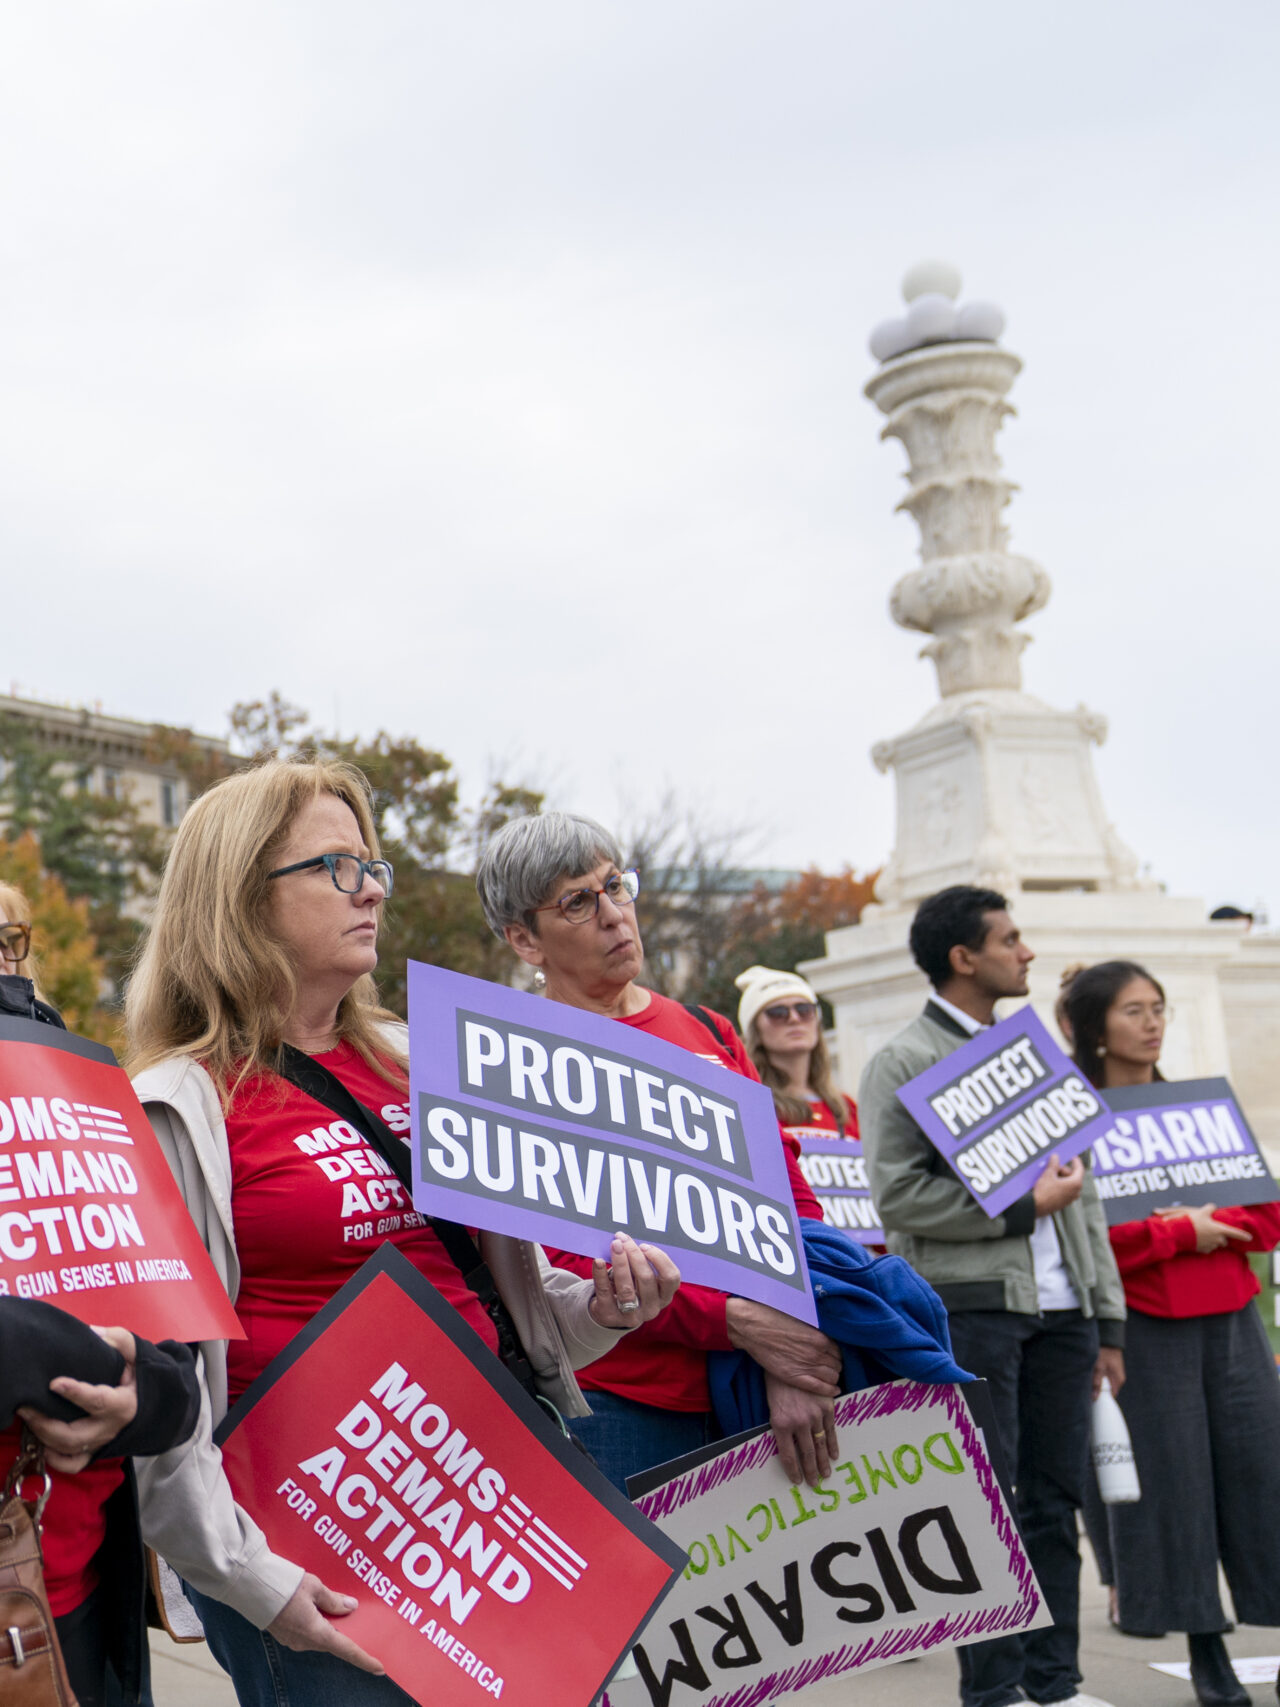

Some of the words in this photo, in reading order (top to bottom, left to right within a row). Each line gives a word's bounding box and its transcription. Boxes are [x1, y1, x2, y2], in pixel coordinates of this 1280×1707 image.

[464, 1020, 736, 1165] PROTECT
[930, 1037, 1048, 1138] PROTECT
[956, 1076, 1100, 1194] SURVIVORS
[1091, 1105, 1246, 1171] ISARM
[344, 1222, 373, 1242] FOR
[377, 1216, 400, 1235] GUN
[426, 1107, 797, 1276] SURVIVORS
[1094, 1166, 1170, 1200] MESTIC
[1166, 1154, 1266, 1188] VIOLENCE
[15, 1270, 58, 1299] GUN
[60, 1262, 116, 1292] SENSE
[115, 1261, 135, 1285] IN
[135, 1258, 192, 1282] AMERICA
[334, 1399, 532, 1603] DEMAND
[369, 1361, 507, 1514] MOMS
[746, 1431, 966, 1543] DOMESTIC
[276, 1477, 317, 1522] FOR
[313, 1515, 352, 1556] GUN
[346, 1548, 402, 1608] SENSE
[397, 1597, 423, 1625] IN
[419, 1618, 506, 1700] AMERICA
[297, 1445, 482, 1626] ACTION
[631, 1505, 983, 1707] DISARM
